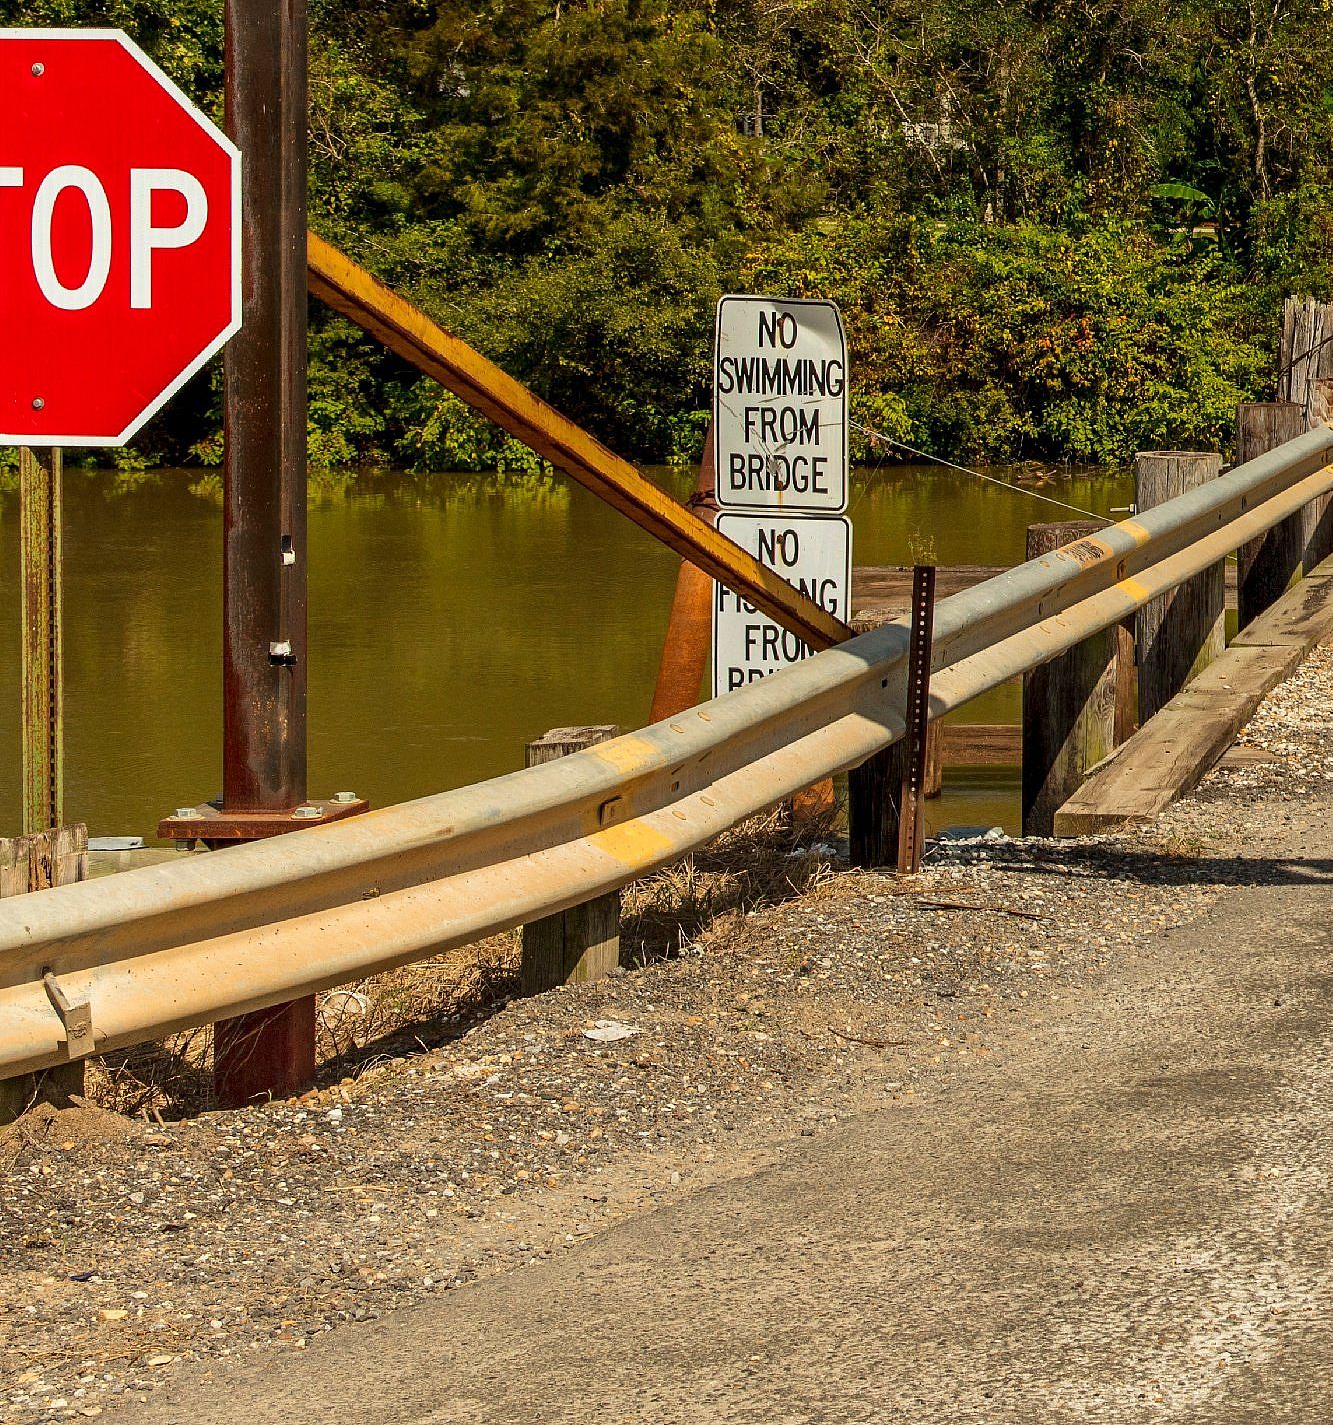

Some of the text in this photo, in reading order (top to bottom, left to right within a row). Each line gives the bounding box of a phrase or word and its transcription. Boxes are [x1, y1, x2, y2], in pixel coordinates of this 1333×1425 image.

[0, 165, 208, 310] OP
[758, 310, 798, 349] NO
[718, 356, 845, 397] SWIMMING
[744, 406, 820, 446] FROM
[729, 453, 828, 494] BRIDGE
[758, 528, 799, 567] NO
